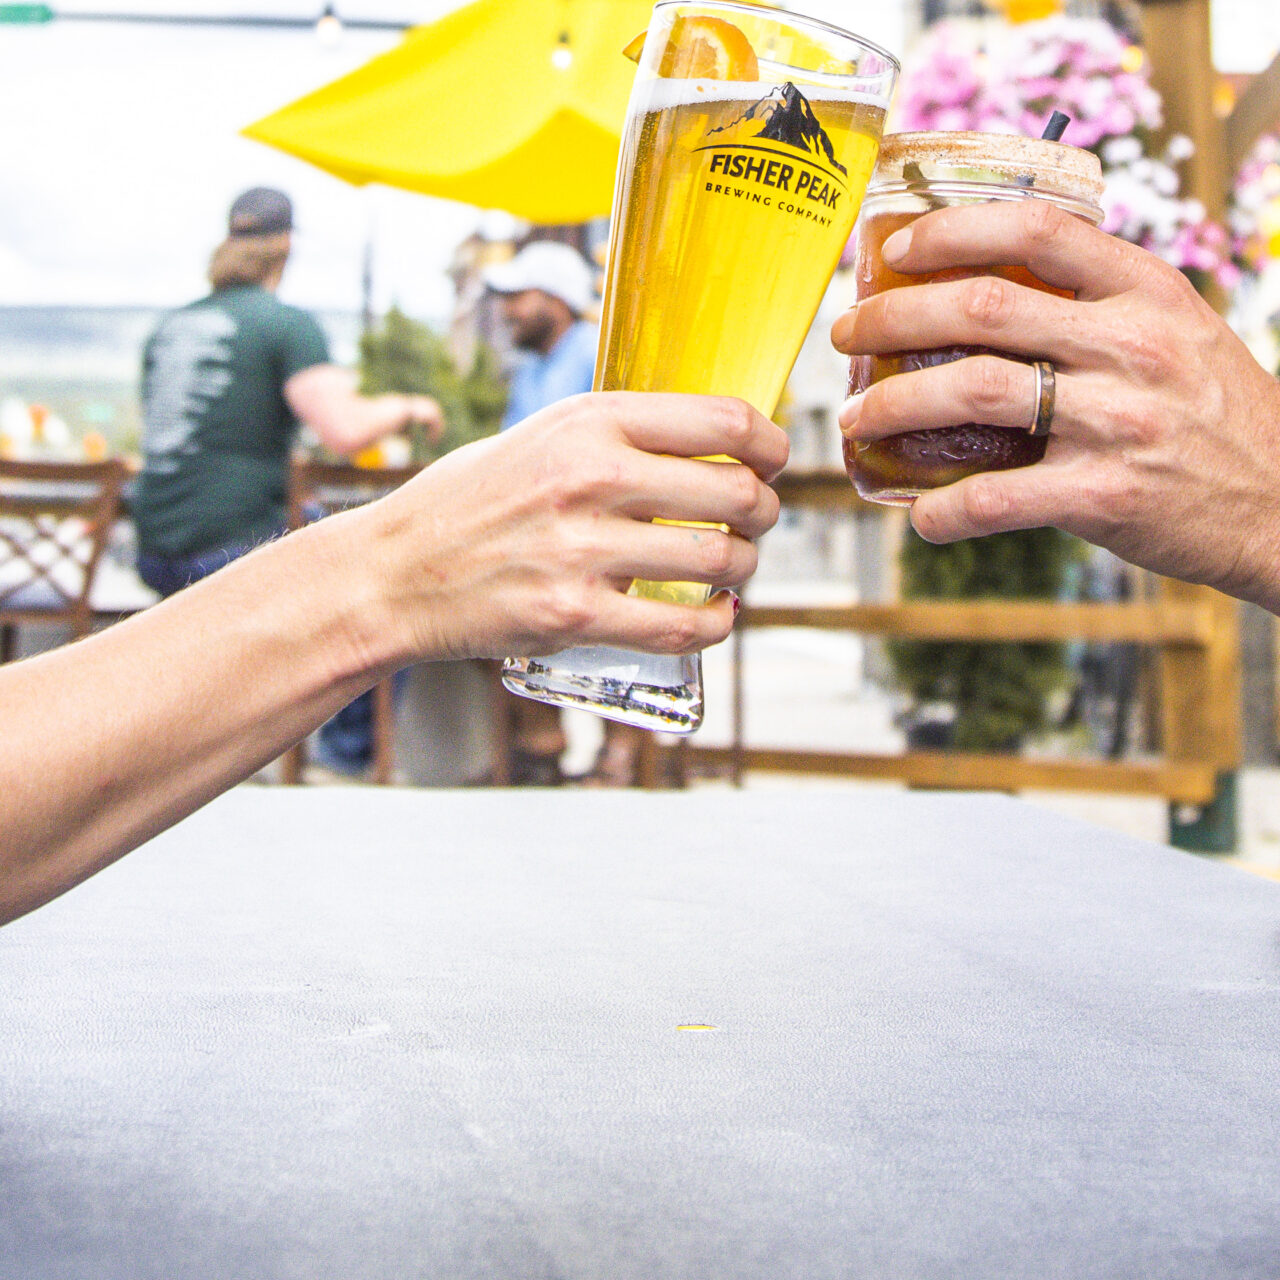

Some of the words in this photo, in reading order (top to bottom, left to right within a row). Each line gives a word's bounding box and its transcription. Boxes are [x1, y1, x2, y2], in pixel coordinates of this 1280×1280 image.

[705, 182, 772, 206] BREWING
[778, 201, 833, 228] COMPANY
[709, 154, 794, 192] FISHER
[794, 170, 842, 210] PEAK
